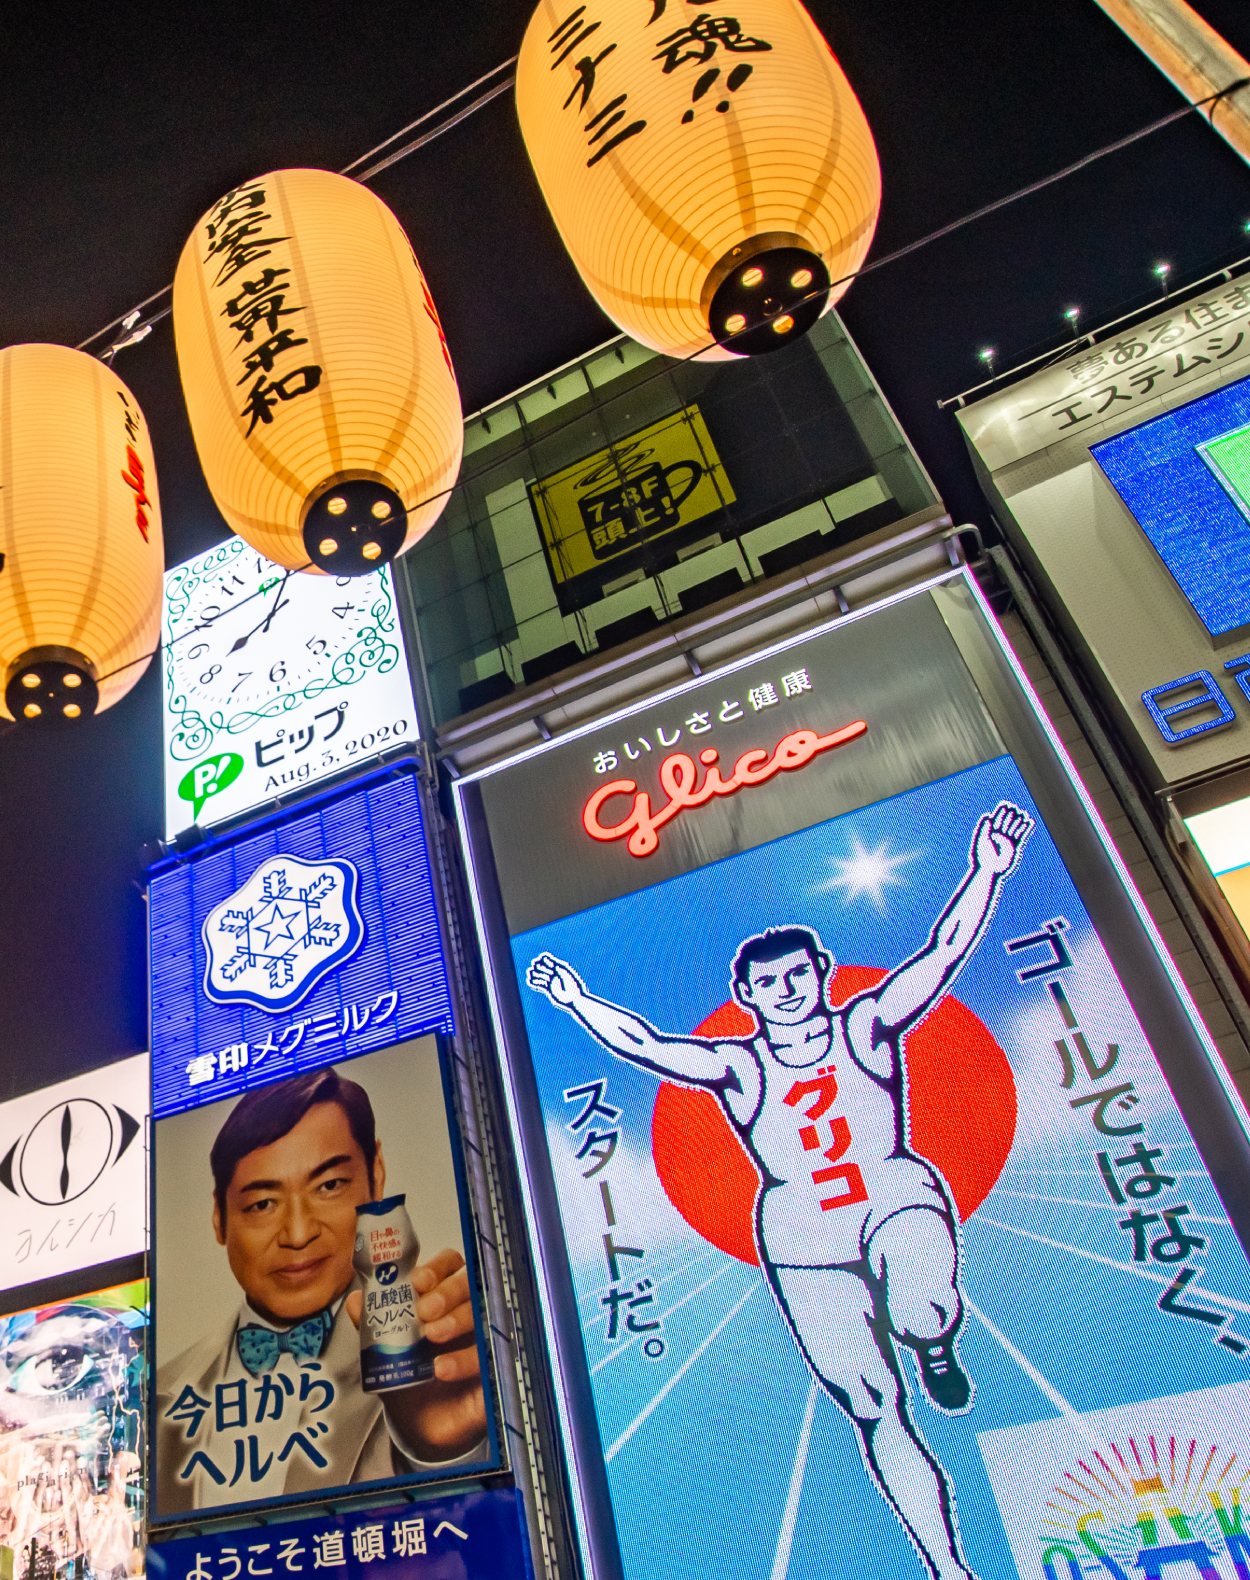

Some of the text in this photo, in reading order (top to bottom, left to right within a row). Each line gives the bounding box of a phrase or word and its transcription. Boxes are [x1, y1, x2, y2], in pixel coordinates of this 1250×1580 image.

[547, 4, 647, 168] 三十三
[645, 0, 773, 125] 魂!!
[194, 605, 221, 632] 10
[331, 602, 355, 621] 4
[199, 664, 223, 684] 8
[268, 660, 287, 682] 6
[305, 635, 327, 656] 5
[231, 671, 253, 693] 7
[254, 701, 349, 768] ピップ
[592, 668, 813, 774] おいしさと健康
[264, 719, 409, 792] Aug. 3, 2020
[582, 719, 869, 857] Glico
[185, 990, 399, 1087] 雪印メグミルク
[782, 1063, 870, 1213] グリコ
[565, 1080, 666, 1358] スタートだ。
[366, 1283, 414, 1312] 乳酸菌
[367, 1304, 415, 1327] ヘルベ
[374, 1323, 411, 1339] ヨーグルト
[164, 1362, 336, 1439] 今日から
[180, 1421, 329, 1488] ヘルベ
[184, 1516, 469, 1580] ようこそ道頓堀へ
